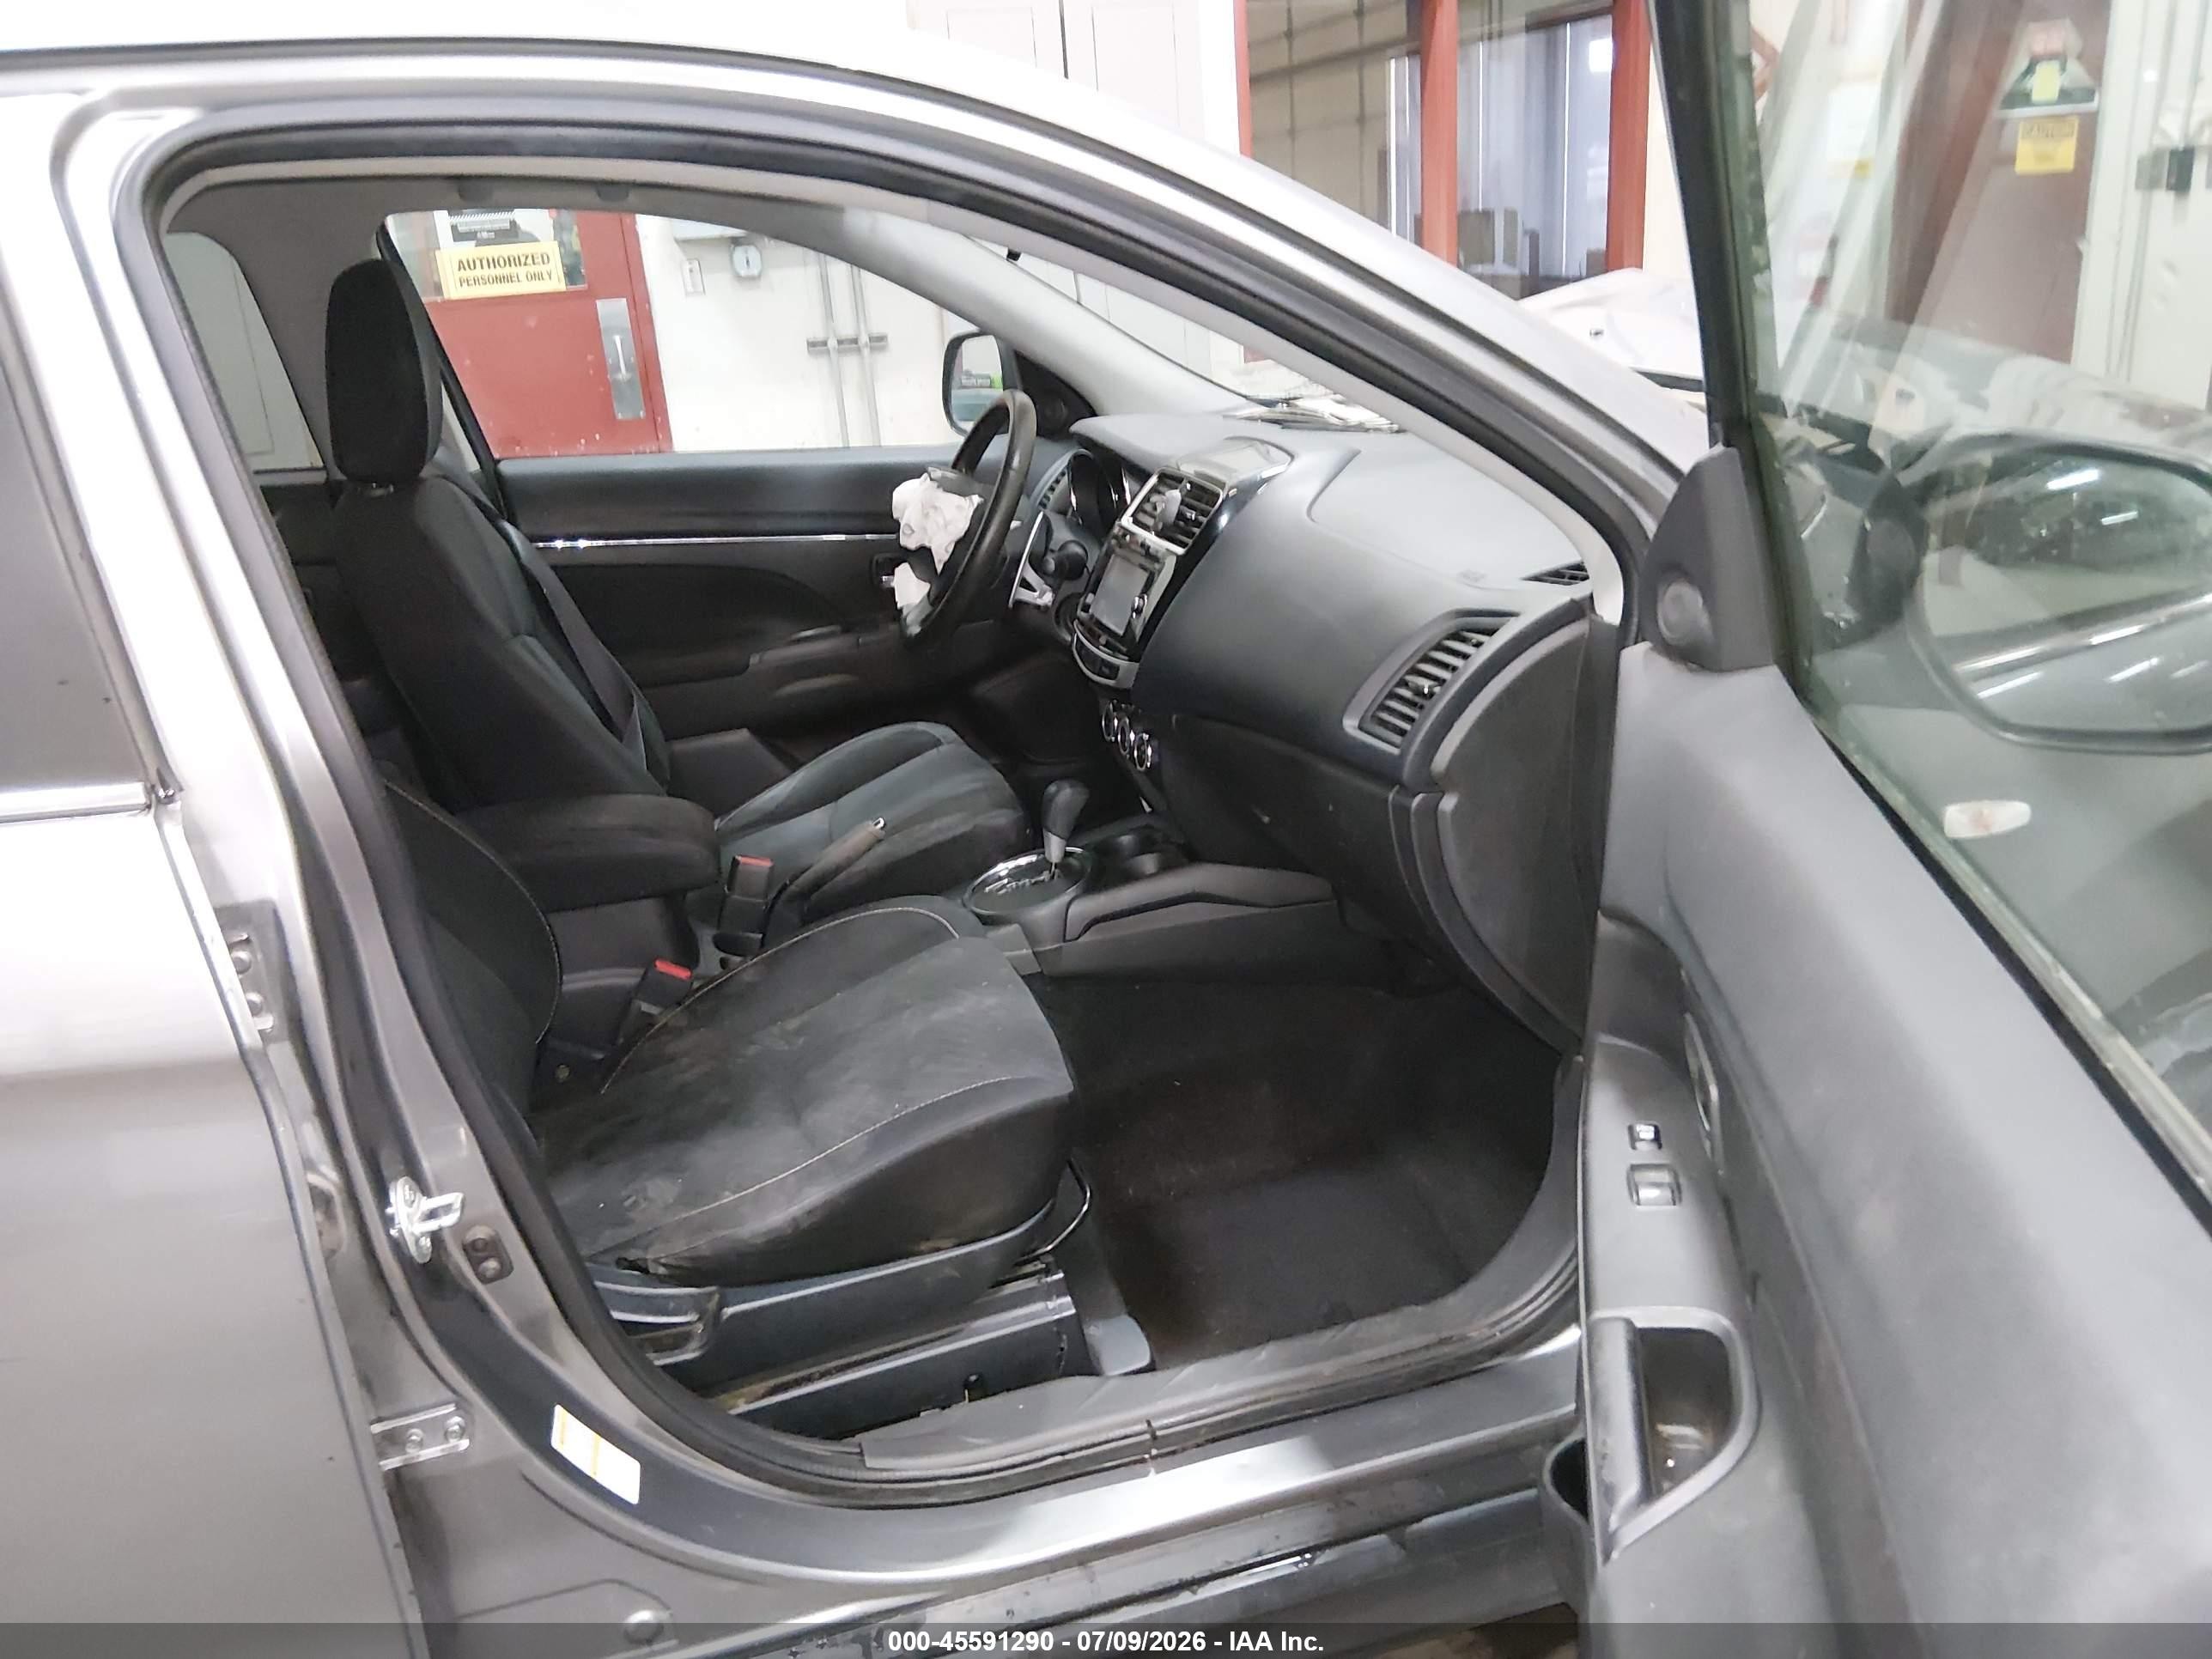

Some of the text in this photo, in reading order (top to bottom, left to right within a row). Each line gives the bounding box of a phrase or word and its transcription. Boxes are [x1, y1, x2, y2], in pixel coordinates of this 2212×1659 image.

[457, 252, 550, 272] AUTHORIZED
[459, 269, 553, 288] PERSONNEL ONLY
